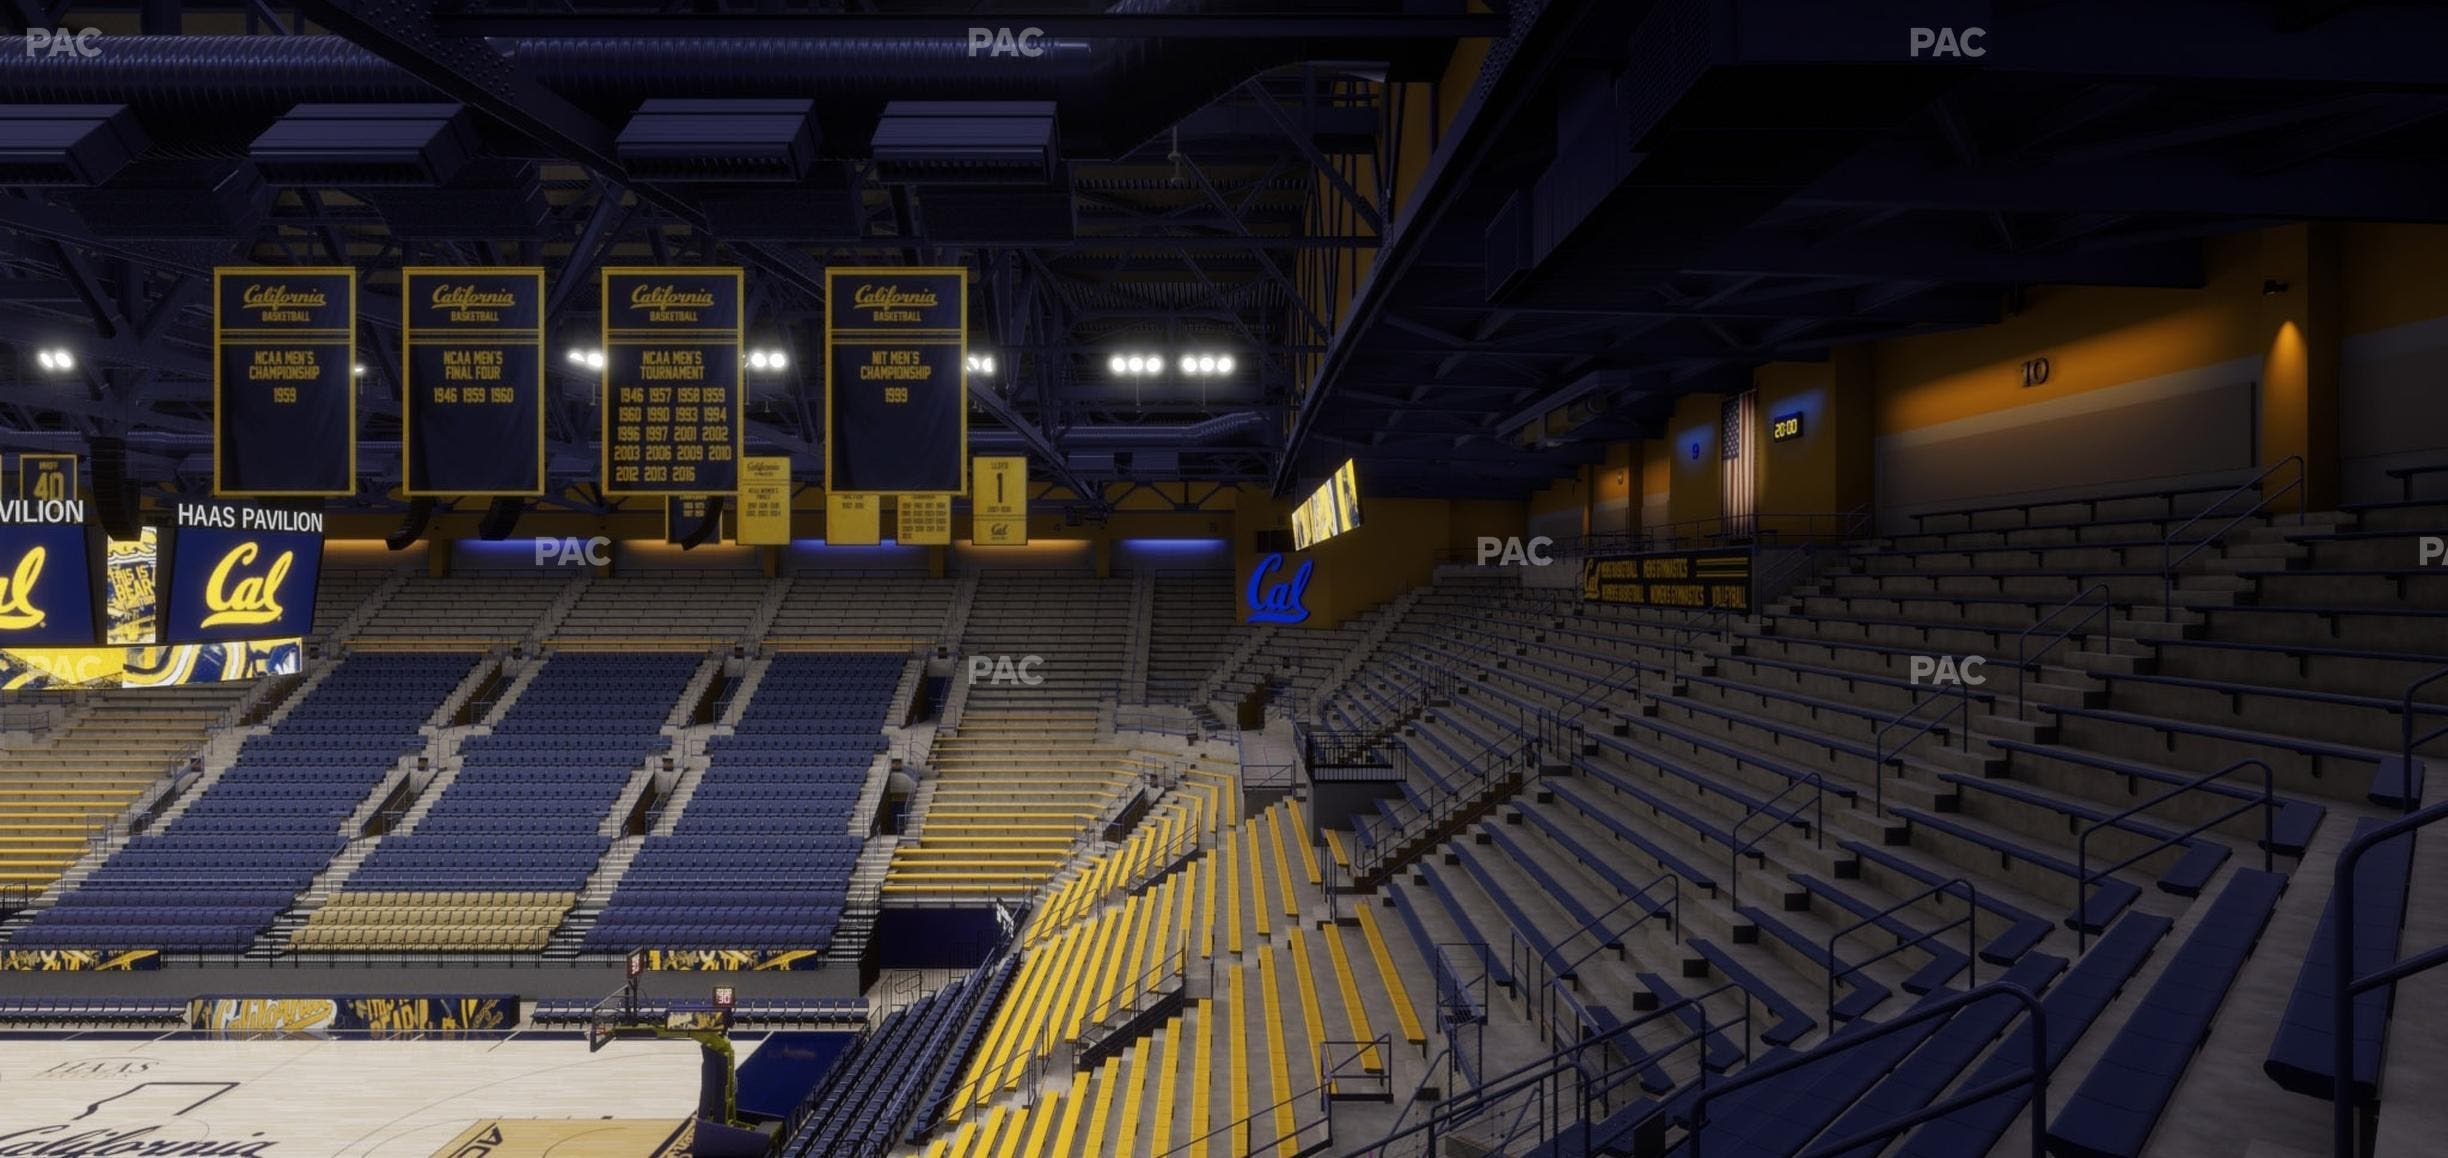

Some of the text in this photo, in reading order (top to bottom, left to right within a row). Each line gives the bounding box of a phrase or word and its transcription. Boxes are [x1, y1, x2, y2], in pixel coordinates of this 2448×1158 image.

[243, 285, 326, 311] California
[432, 284, 515, 311] California
[630, 284, 714, 311] California
[854, 284, 938, 311] California
[262, 310, 309, 321] BASKETBALL
[451, 310, 498, 321] BASKETBALL
[651, 310, 697, 321] BASKETBALL
[874, 310, 921, 321] BASKETBALL
[255, 352, 313, 364] NCAA MEN'S
[443, 352, 503, 364] NCAA MEN'S
[643, 352, 701, 365] NCAA MEN'S
[872, 352, 918, 365] NIT MEN'S
[251, 365, 319, 379] CHAMPIONSHIP
[446, 365, 500, 379] FINAL FOUR
[641, 365, 704, 379] TOURNAMENT
[862, 365, 930, 378] CHAMPIONSHIP
[2021, 357, 2050, 387] 10
[273, 388, 296, 403] 1959
[434, 388, 513, 403] 1946 1959 1960
[622, 388, 724, 403] 1946 1957 1958 1959
[886, 388, 907, 402] 1999
[620, 407, 726, 421] 1960 1990 1993 1994
[618, 426, 727, 441] 1996 1997 2001 2002
[1774, 421, 1798, 439] 20:00
[616, 444, 731, 461] 2003 2006 2009 2010
[1692, 443, 1700, 459] 9
[617, 466, 694, 481] 2012 2013 2016
[33, 471, 64, 500] 40
[996, 472, 1004, 504] 1
[179, 504, 322, 532] HAAS PAVILION
[135, 565, 150, 578] IS
[199, 540, 294, 630] Cal
[1245, 551, 1314, 624] Cal
